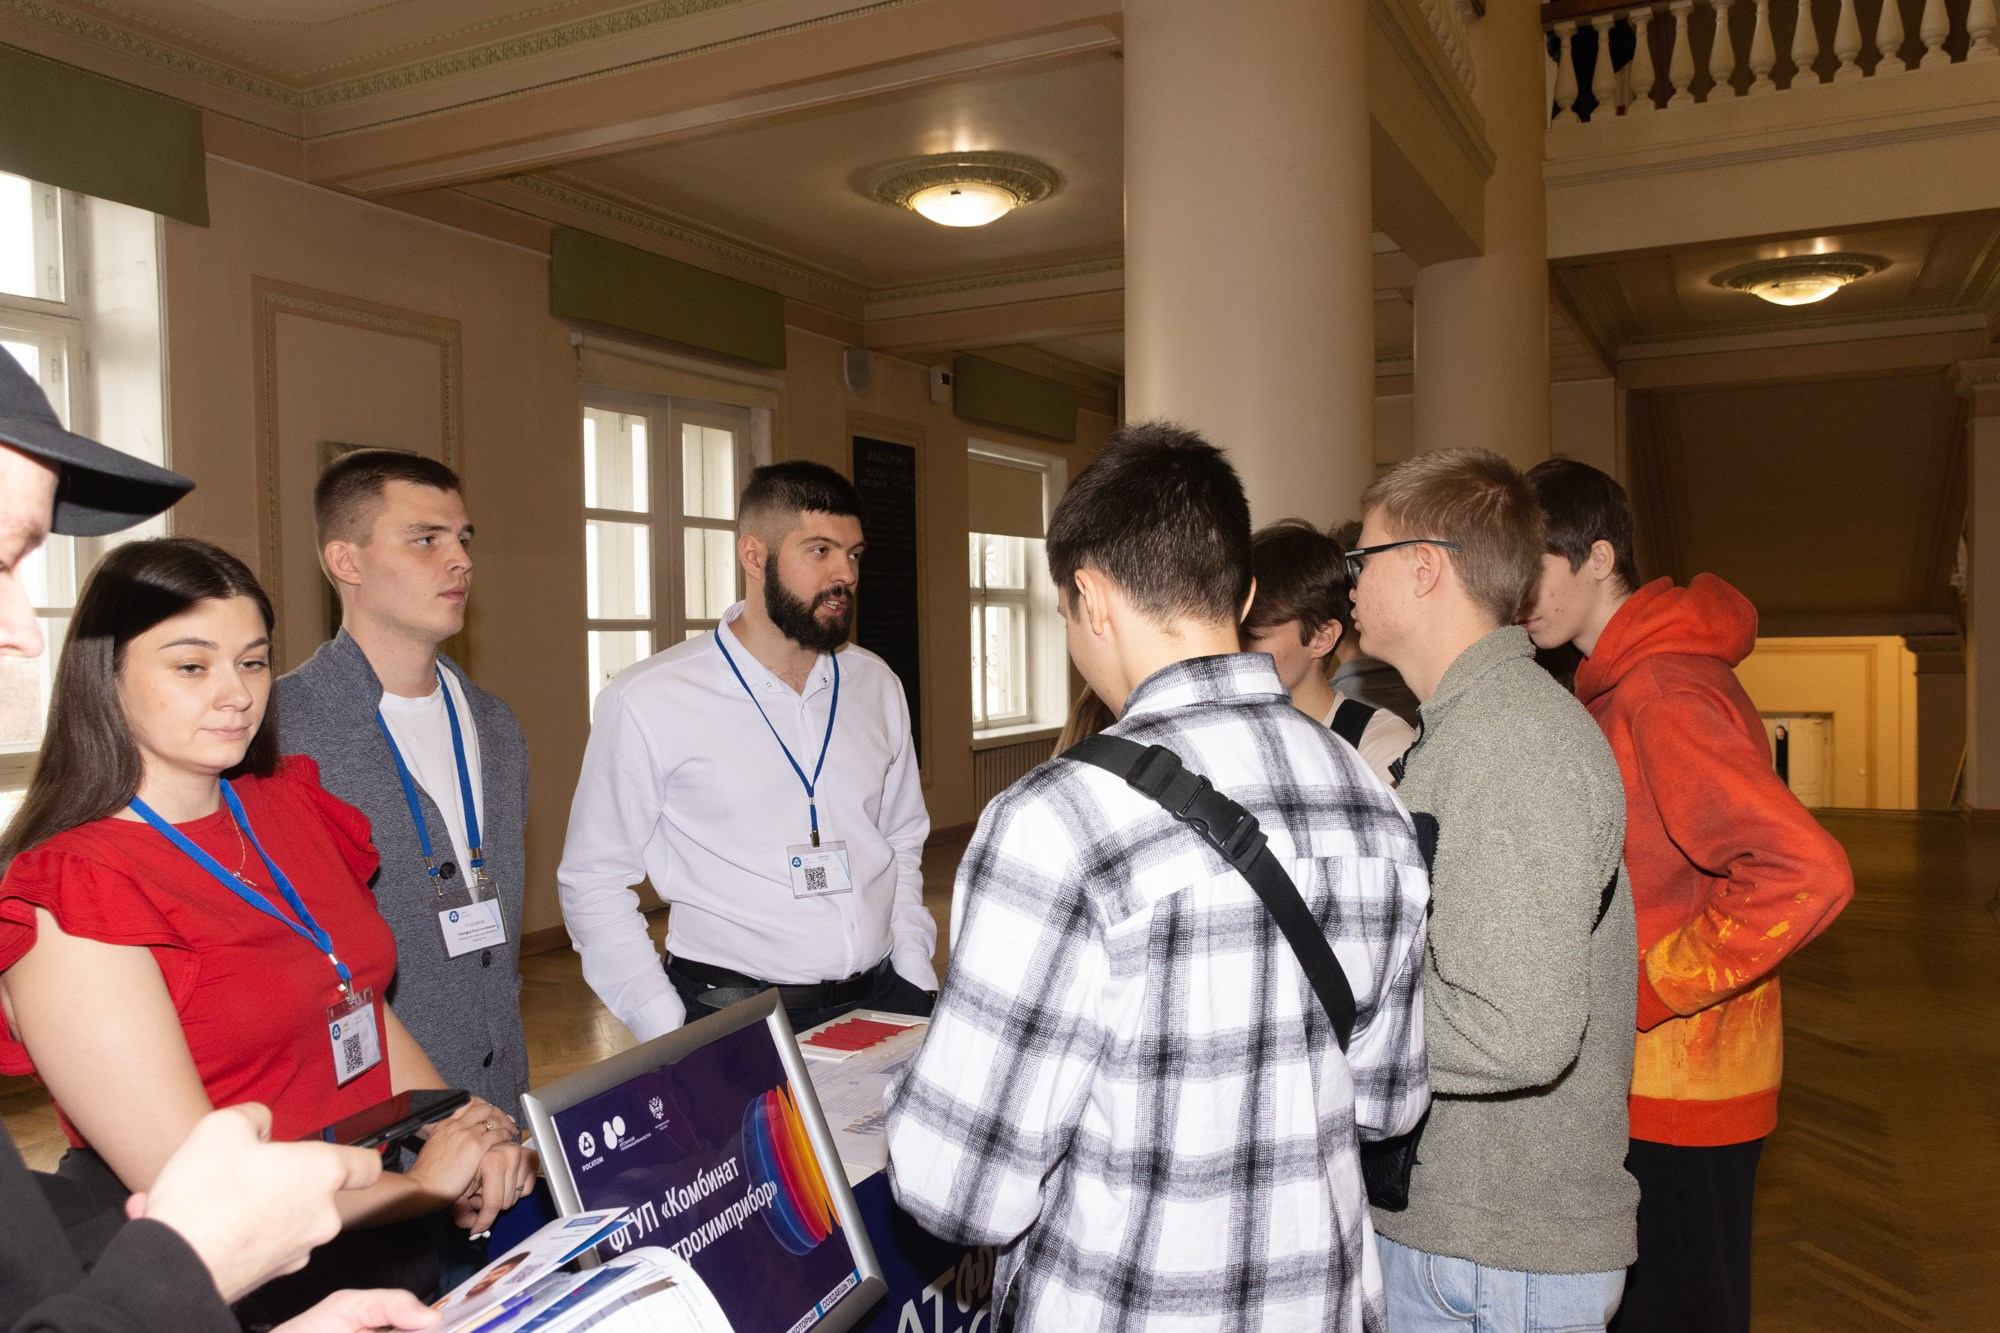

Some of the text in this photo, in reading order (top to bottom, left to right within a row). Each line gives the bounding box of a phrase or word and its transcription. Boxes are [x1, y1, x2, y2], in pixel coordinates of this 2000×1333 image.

[582, 1156, 604, 1172] РОСАТОМ
[609, 1200, 660, 1253] ФГУП
[661, 1156, 739, 1220] «Комбинат
[668, 1180, 778, 1267] трохимприбор»
[846, 1274, 856, 1287] ТЫ
